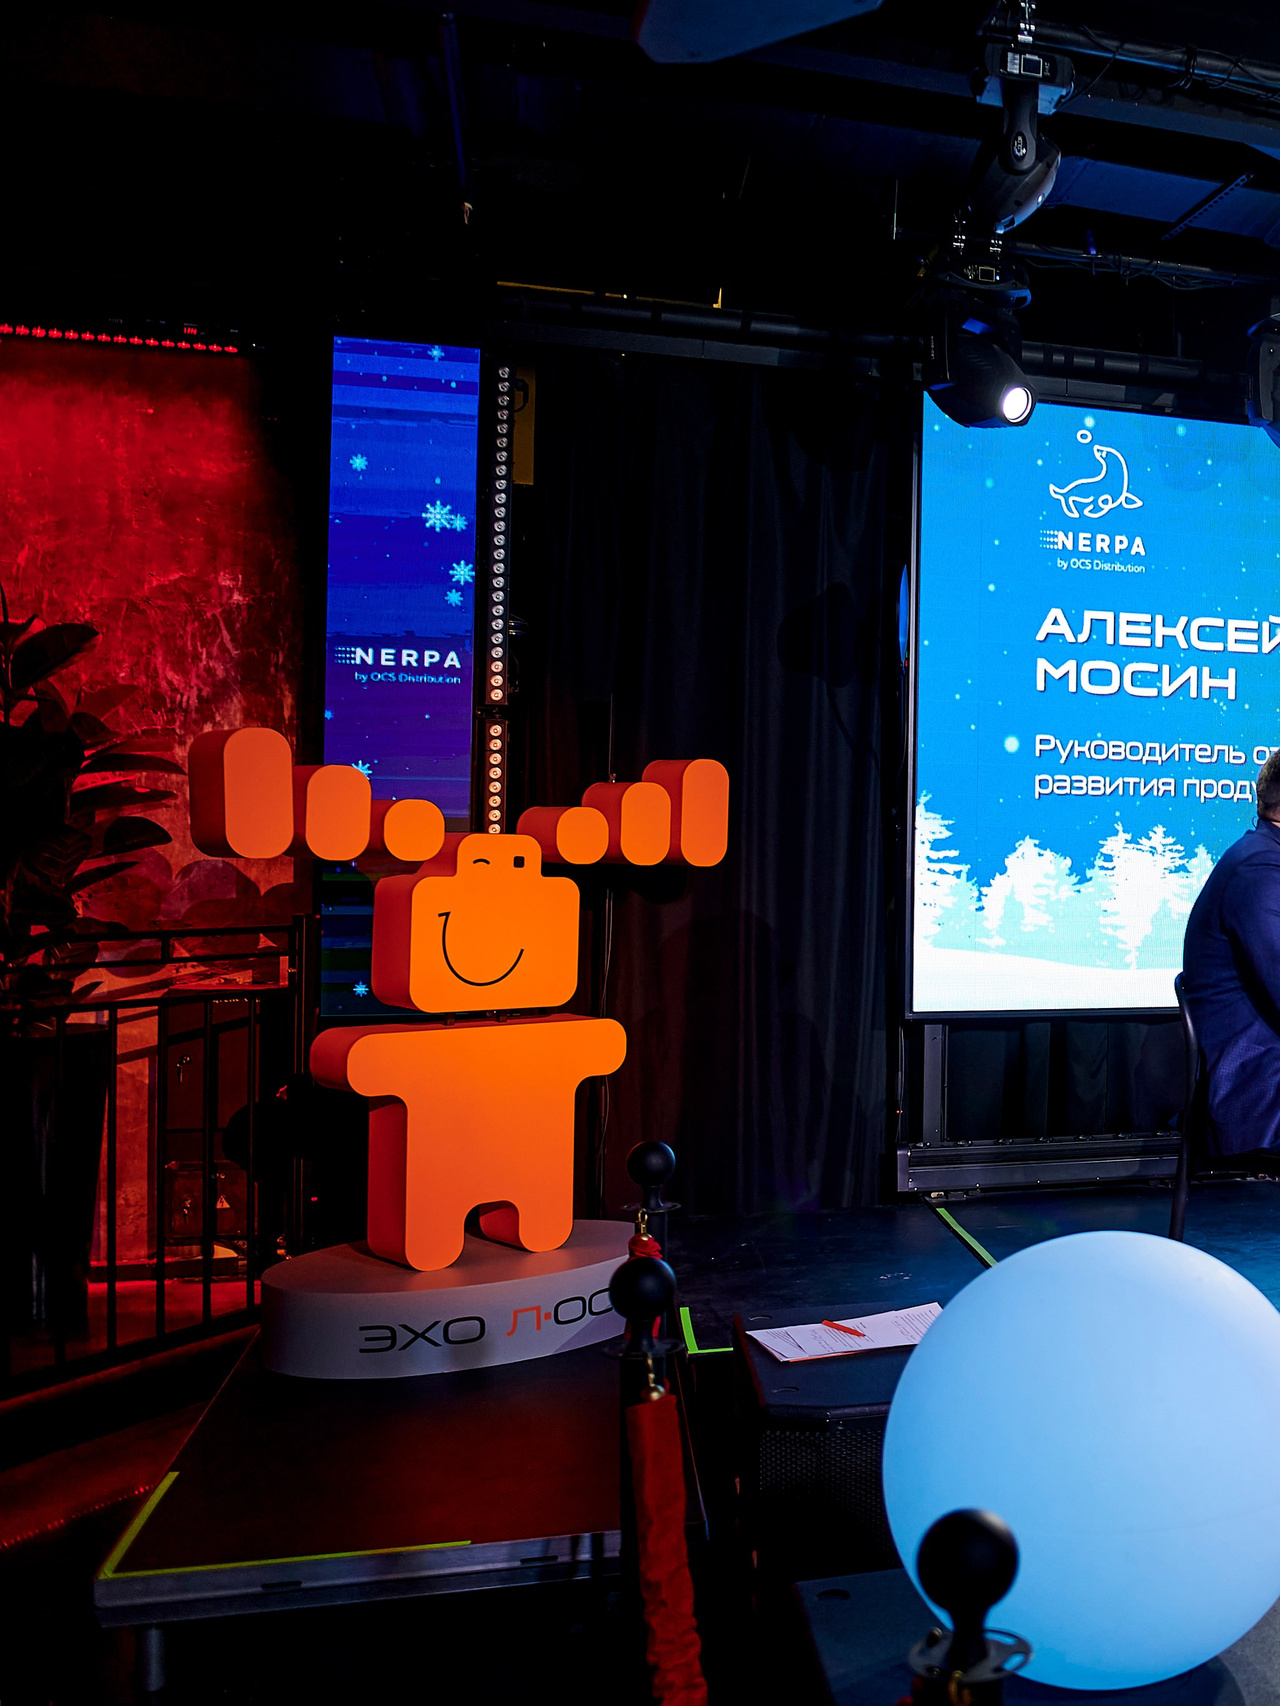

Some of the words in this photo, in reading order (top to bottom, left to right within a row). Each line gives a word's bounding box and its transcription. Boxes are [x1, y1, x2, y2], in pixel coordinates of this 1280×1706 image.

[1057, 530, 1146, 556] NERPA
[1057, 557, 1068, 570] by
[1070, 558, 1092, 570] OCS
[1093, 560, 1146, 573] Distribution
[355, 647, 461, 668] NERPA
[355, 671, 368, 683] by
[370, 672, 397, 682] OCS
[398, 673, 461, 684] Distribution
[1036, 657, 1237, 701] МОСИН
[1035, 734, 1246, 766] Руководитель
[1034, 773, 1176, 799] развития
[358, 1315, 486, 1354] ЭХО
